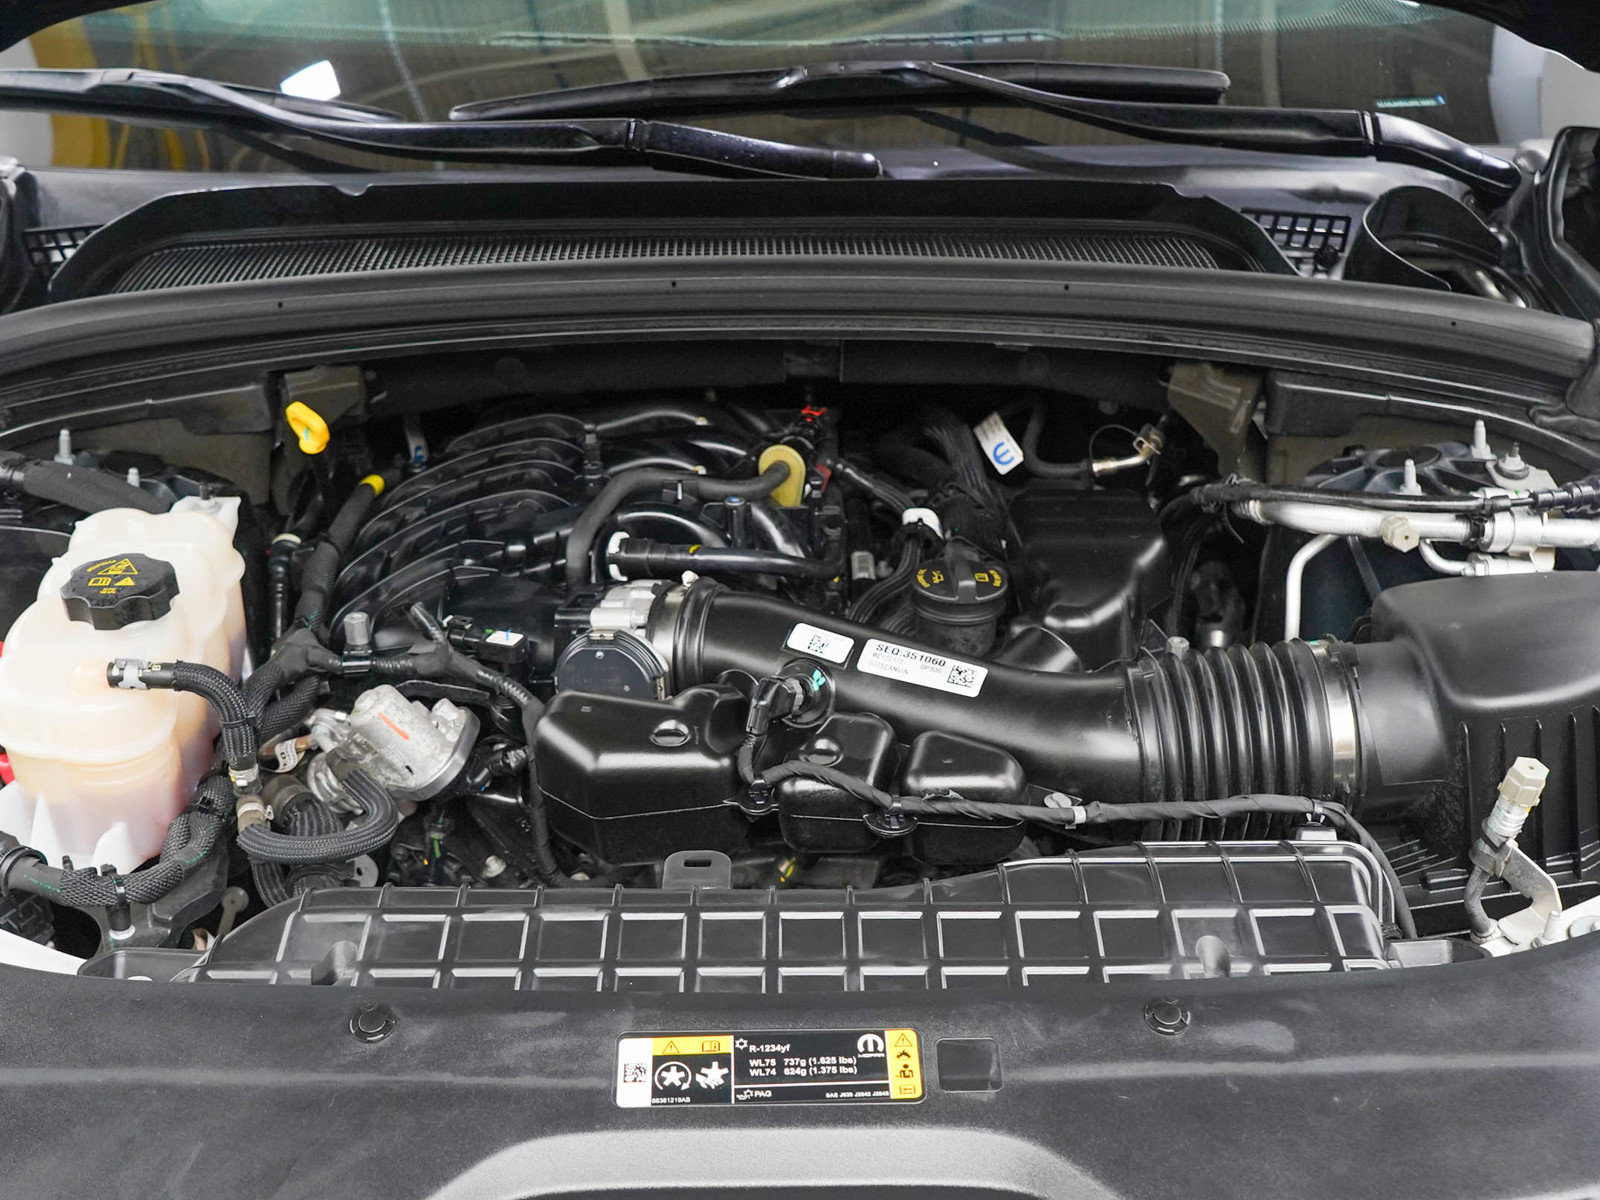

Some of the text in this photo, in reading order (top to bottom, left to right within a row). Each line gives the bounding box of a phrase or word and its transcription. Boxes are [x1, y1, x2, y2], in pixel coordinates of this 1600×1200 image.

[749, 1044, 790, 1053] R-1234yf
[749, 1056, 857, 1067] WL75 737g (1.625 lbs)
[749, 1066, 858, 1076] WL74 624g (1.375 lbs)
[754, 1090, 772, 1098] PAG
